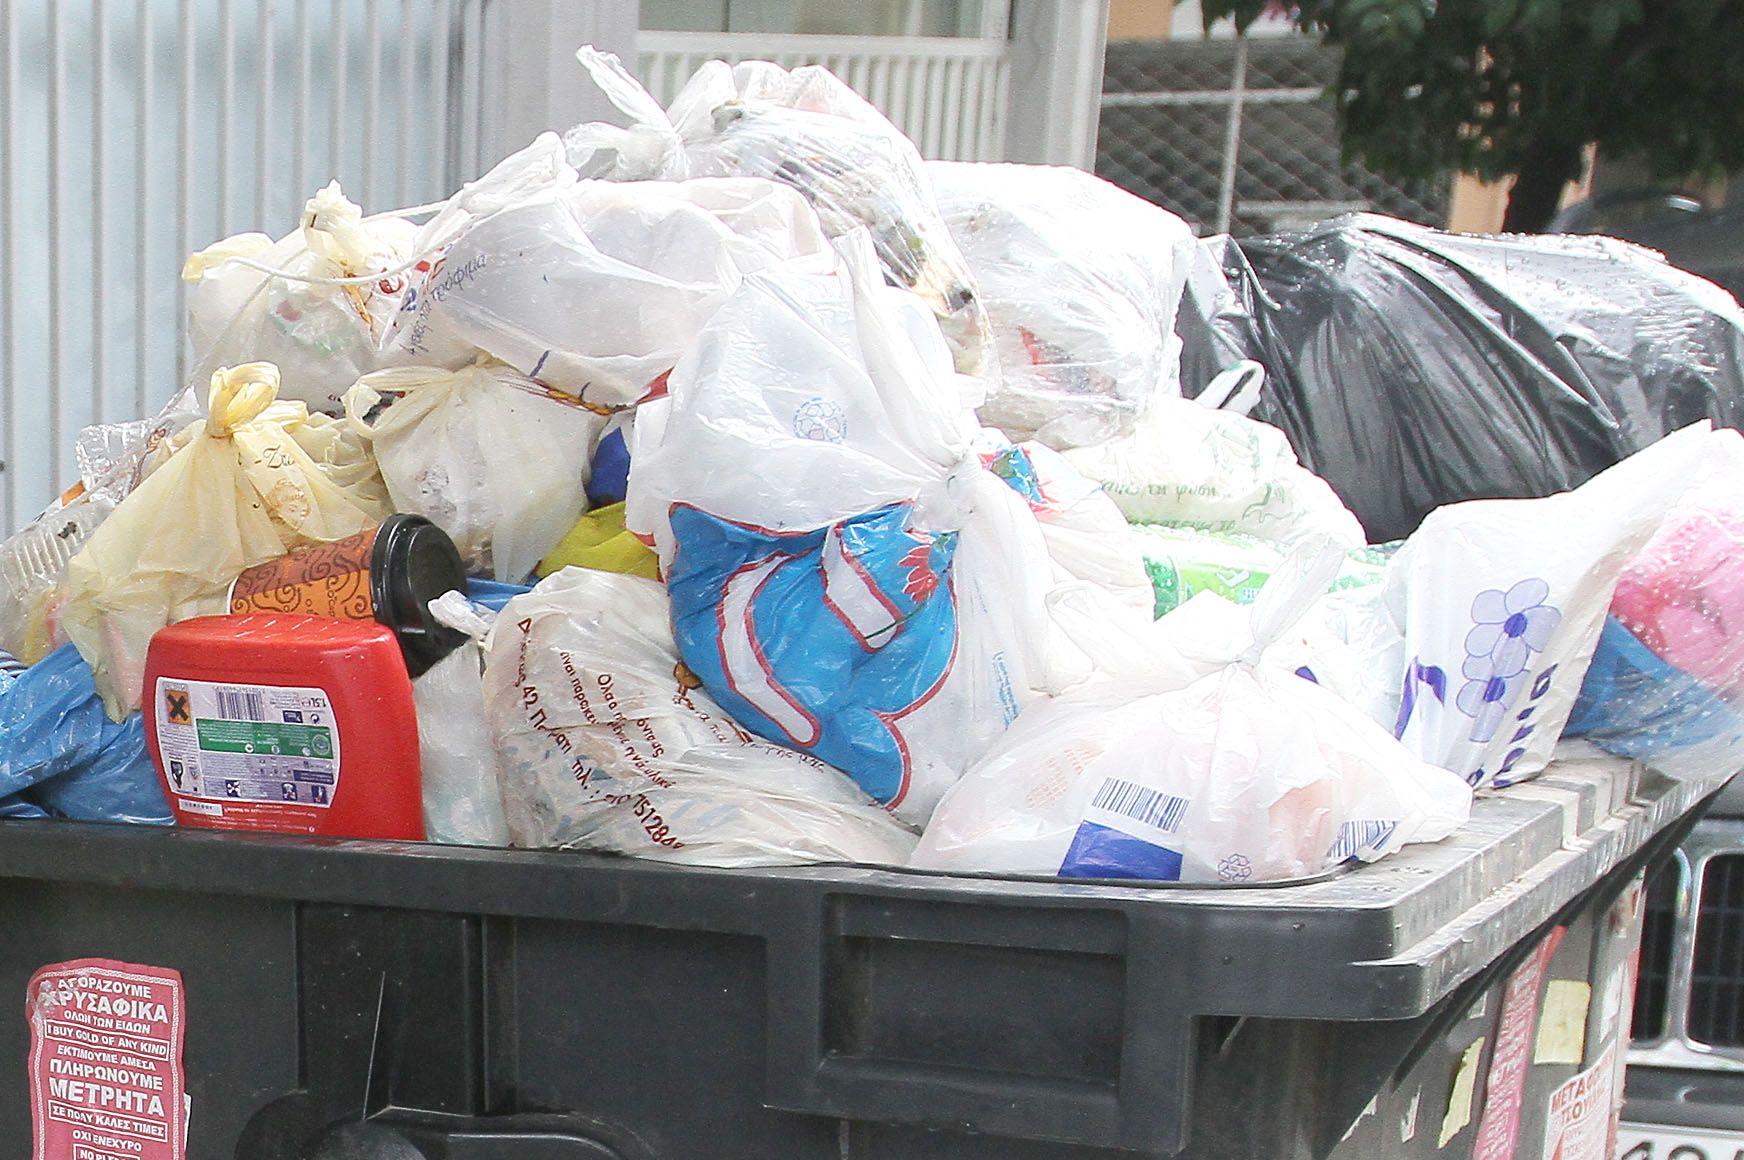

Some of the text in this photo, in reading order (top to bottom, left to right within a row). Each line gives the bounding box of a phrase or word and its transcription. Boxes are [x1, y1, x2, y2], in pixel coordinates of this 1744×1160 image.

[521, 684, 539, 711] 42
[57, 975, 153, 999] ΑΓΟΡΑΖΟΥΜΕ
[115, 1018, 152, 1035] ΕΙΔΩΝ
[53, 1025, 74, 1039] BUY
[75, 1028, 100, 1045] GOLD
[102, 1034, 116, 1047] OF
[117, 1036, 139, 1051] ANY
[140, 1040, 168, 1057] KIND
[57, 1044, 156, 1072] ΕΚΤΙΜΟΥΜΕ ΑΜΕΣΑ
[49, 1058, 164, 1092] ΠΛΗΡΩΝΟΥΜΕ
[48, 1077, 165, 1118] ΜΕΤΡΗΤΑ
[95, 1113, 132, 1132] ΚΑΛΕΣ
[132, 1120, 165, 1138] ΤΙΜΕΣ
[72, 1130, 143, 1153] ΟΧΙ ΕΝΕΧΥΡΟ
